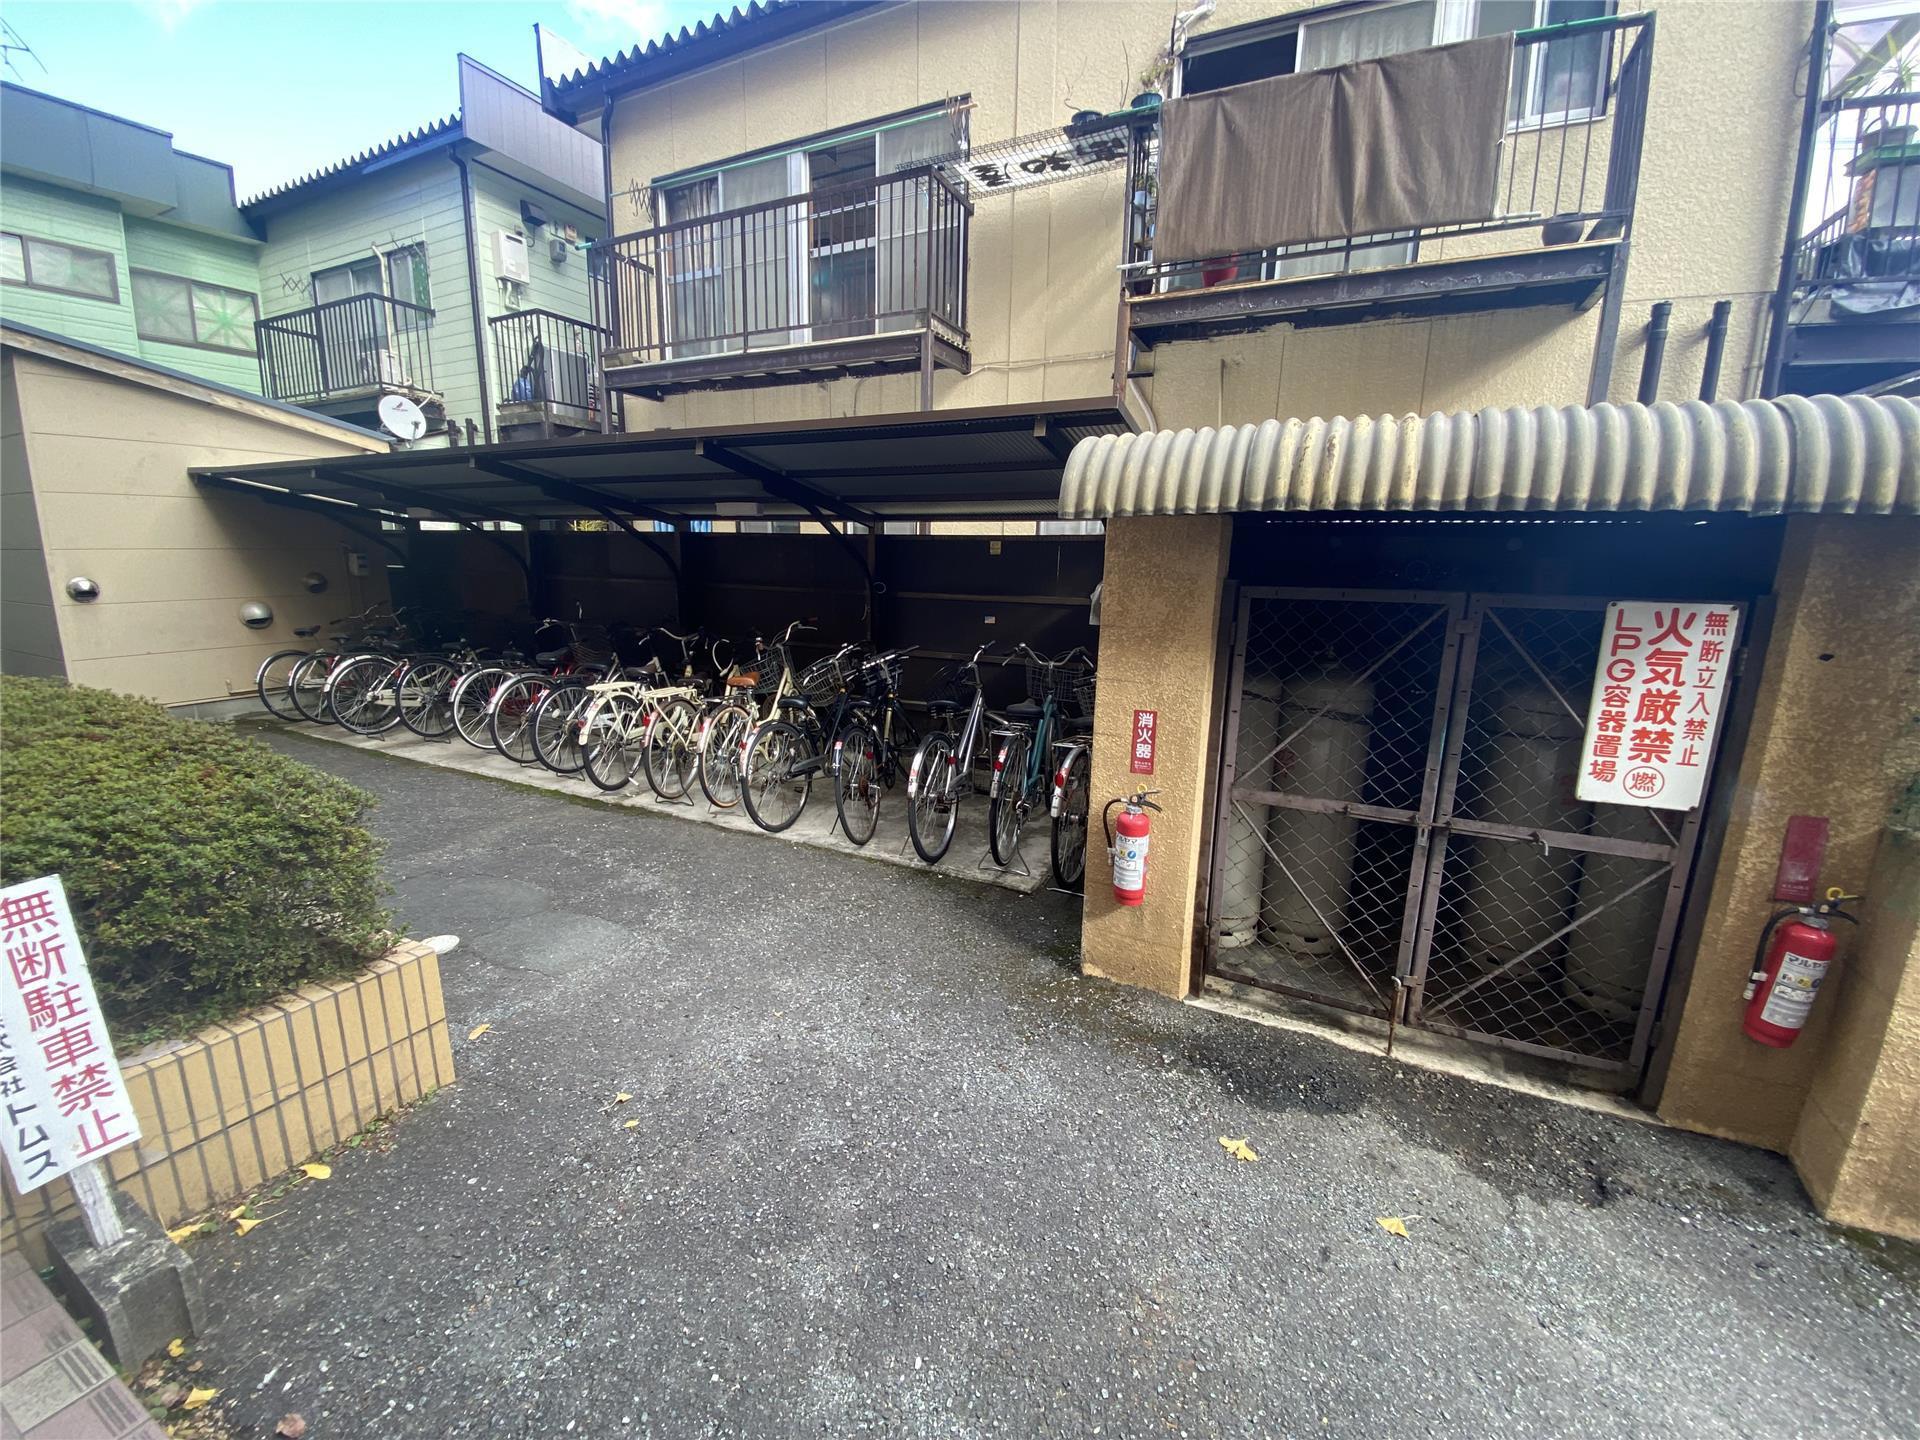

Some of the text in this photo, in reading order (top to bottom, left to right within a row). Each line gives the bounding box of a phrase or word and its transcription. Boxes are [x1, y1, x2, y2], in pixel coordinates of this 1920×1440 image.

[1136, 712, 1154, 758] 消火器
[1588, 608, 1642, 783] LPG容器置場
[1628, 607, 1697, 764] 火気厳禁
[1676, 611, 1730, 767] 無断立入禁止
[0, 890, 130, 1158] 無断駐車禁止
